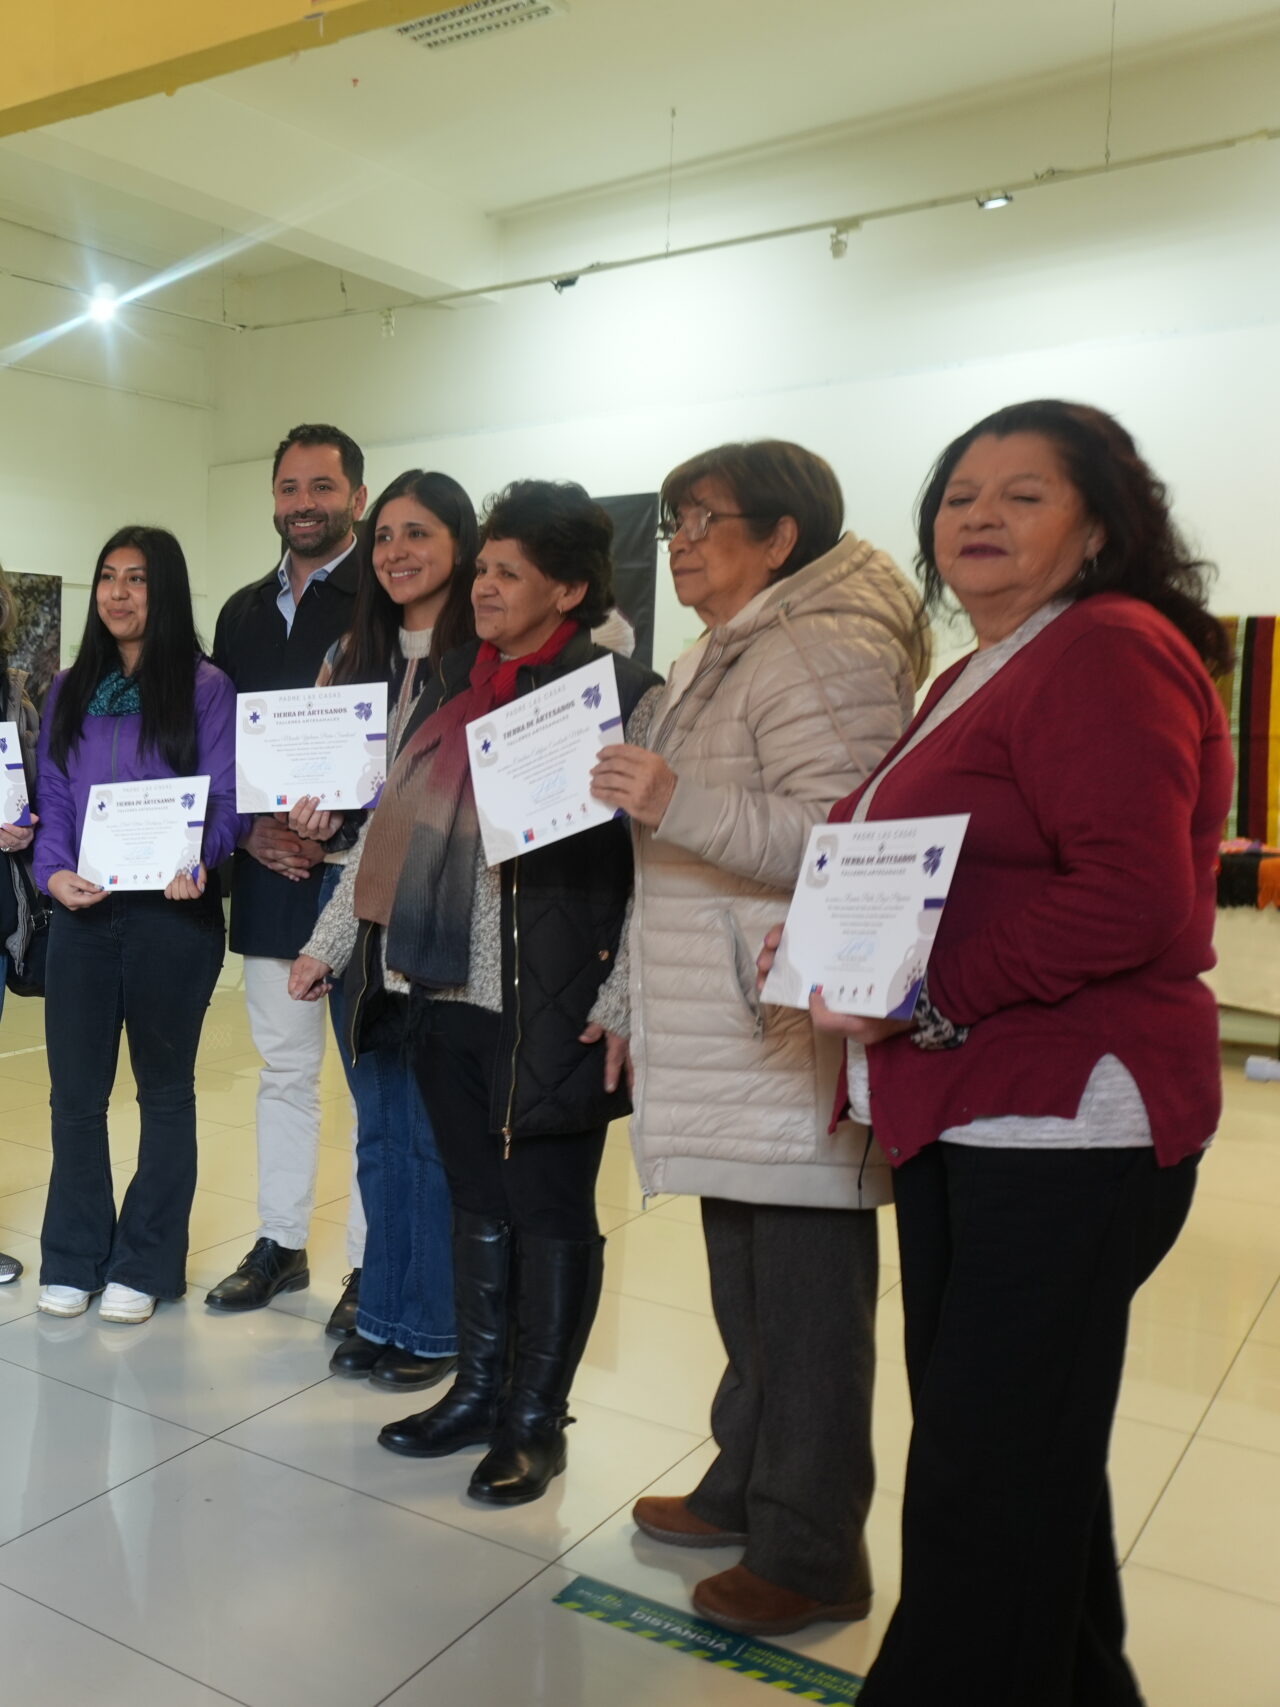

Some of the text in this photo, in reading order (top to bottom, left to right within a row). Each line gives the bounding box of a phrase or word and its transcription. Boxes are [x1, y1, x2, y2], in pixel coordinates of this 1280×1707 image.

[529, 697, 542, 708] LAS
[273, 711, 297, 719] TIERRA
[307, 708, 348, 716] ARTESANOS
[503, 700, 575, 740] TIERRA DE ARTESANOS
[865, 856, 875, 865] DE
[630, 1610, 729, 1652] DISTANCIA
